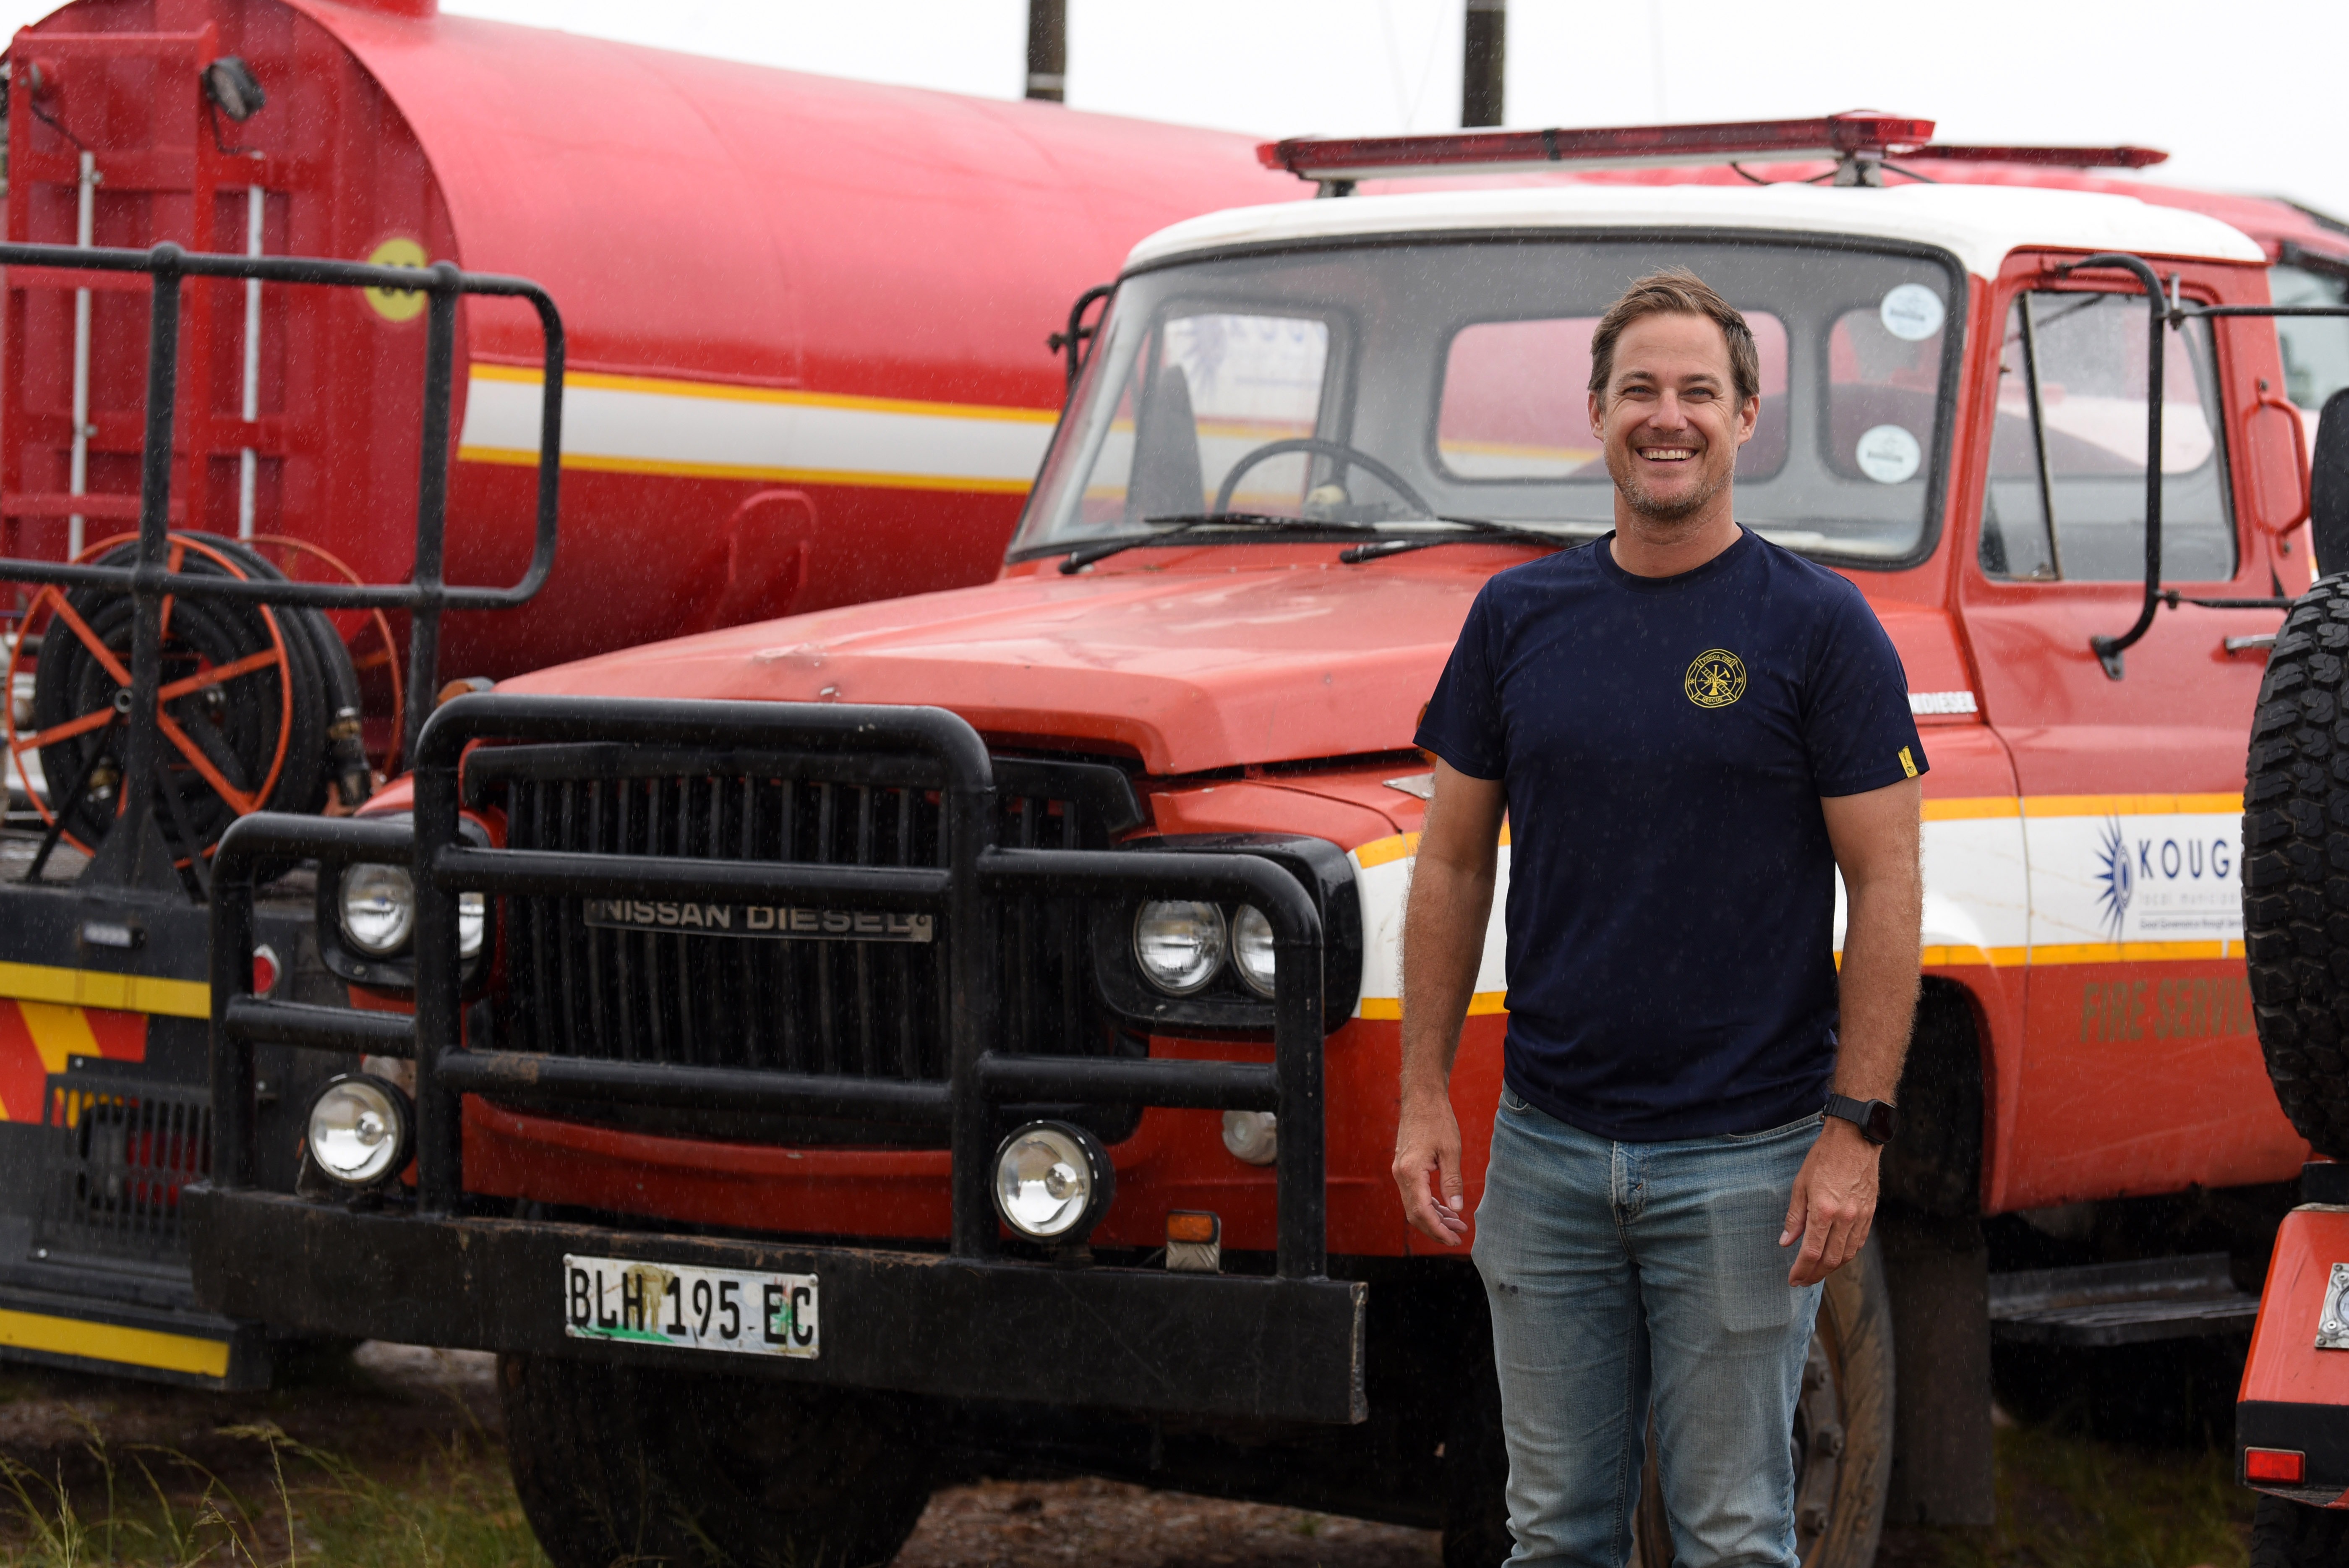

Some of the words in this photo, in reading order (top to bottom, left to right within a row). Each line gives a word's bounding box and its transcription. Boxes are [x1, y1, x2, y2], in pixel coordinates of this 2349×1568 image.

[1703, 655, 1720, 663] KOUGA
[2139, 840, 2241, 879] KOUG
[599, 900, 731, 929] NISSAN
[747, 906, 910, 934] DIESEL
[2080, 980, 2148, 1043] FIRE
[2153, 977, 2254, 1041] SERVIC
[570, 1268, 644, 1331] BLH
[666, 1276, 740, 1339] 195
[763, 1284, 813, 1346] EC
